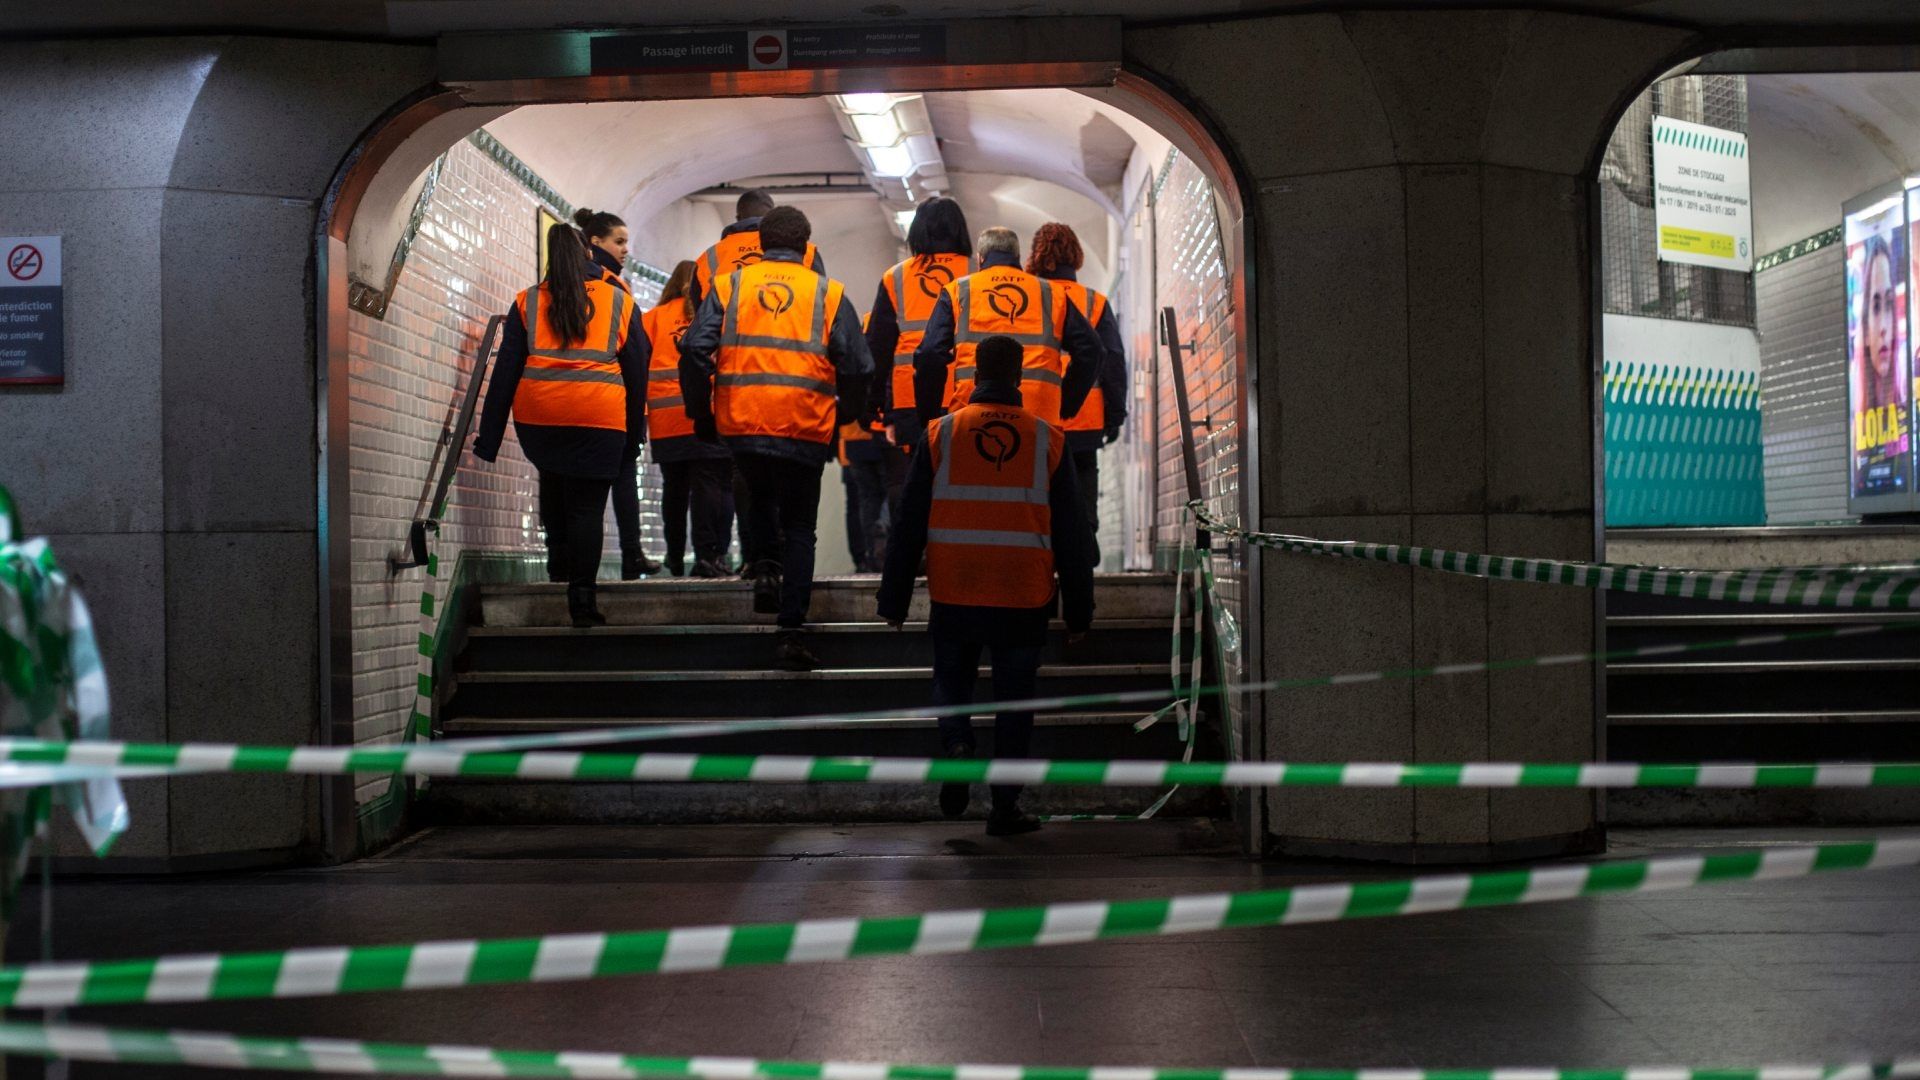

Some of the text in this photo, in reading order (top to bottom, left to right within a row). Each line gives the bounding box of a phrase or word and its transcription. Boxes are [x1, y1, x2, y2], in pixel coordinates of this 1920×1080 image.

[642, 43, 734, 58] Passage interdit
[0, 301, 52, 311] nterdiction
[10, 312, 40, 322] fumer
[10, 331, 44, 341] smoking
[980, 411, 1021, 420] RATP
[1856, 402, 1899, 451] LOLA
